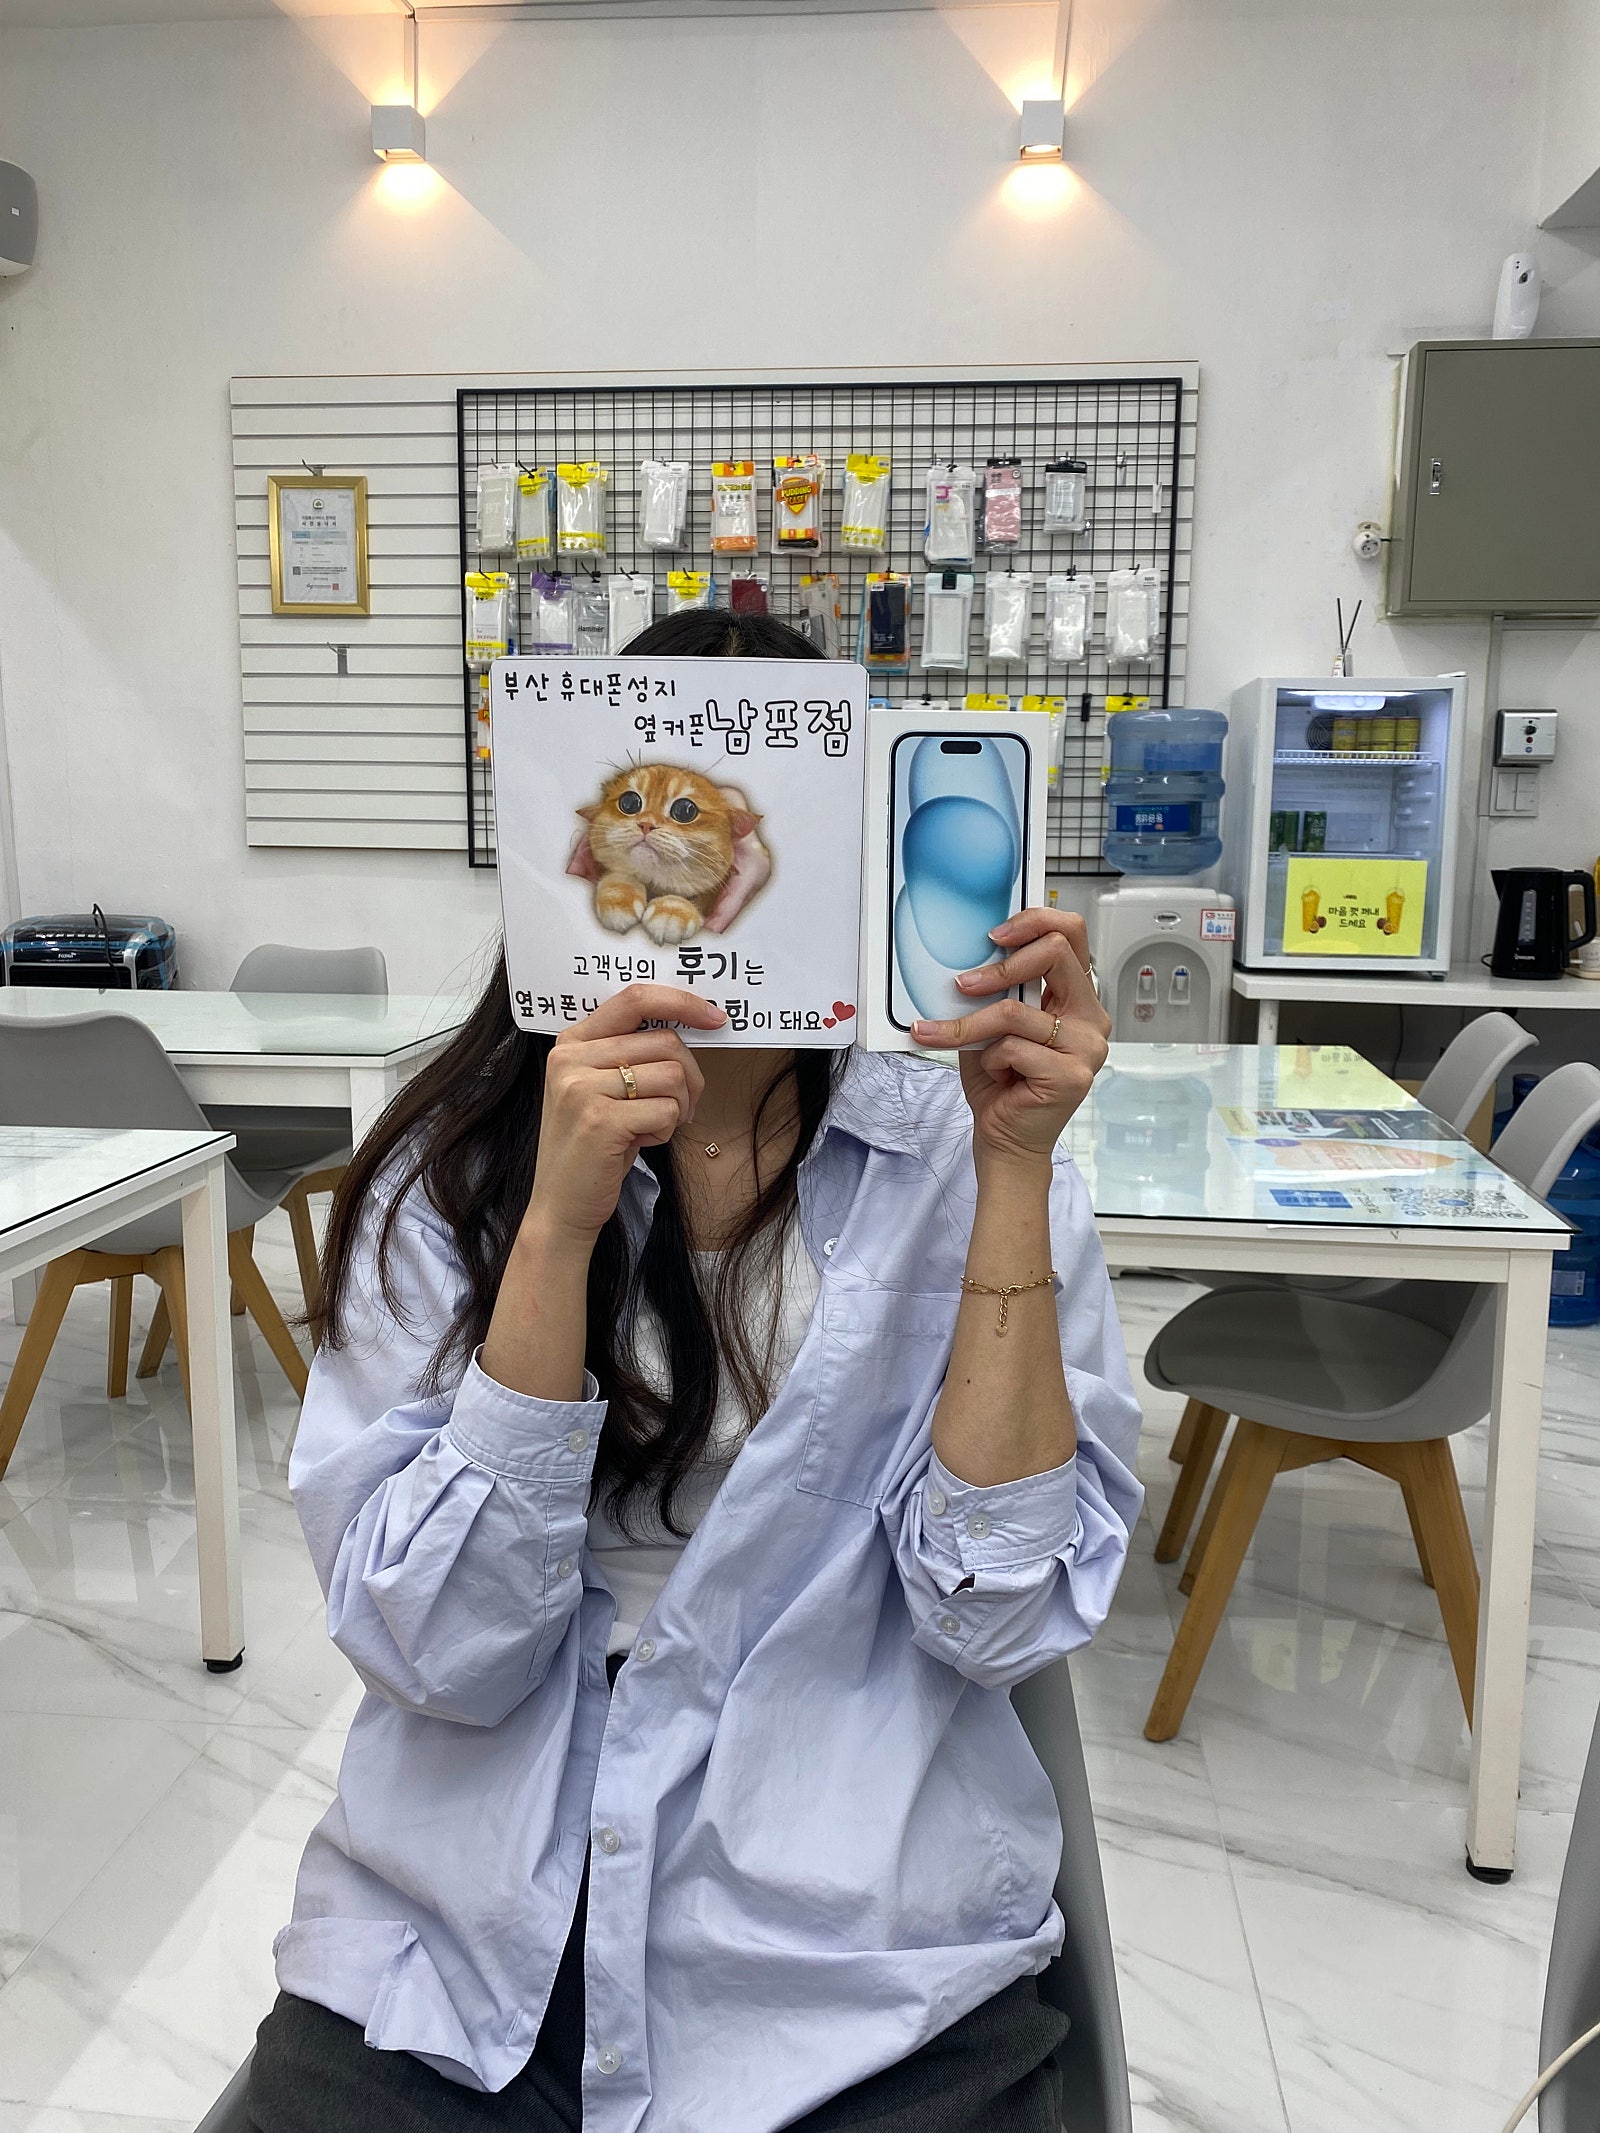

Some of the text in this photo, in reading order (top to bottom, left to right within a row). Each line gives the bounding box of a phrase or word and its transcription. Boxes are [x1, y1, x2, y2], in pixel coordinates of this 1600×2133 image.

[782, 485, 812, 498] PUDDING
[788, 495, 804, 505] CASE
[578, 625, 605, 633] Hammer
[504, 671, 677, 707] 부산 휴대폰성지
[1361, 907, 1380, 916] 꺼내
[1339, 918, 1367, 929] 드세요
[573, 945, 765, 986] 고객님의 후기는
[779, 1009, 823, 1031] 돼요
